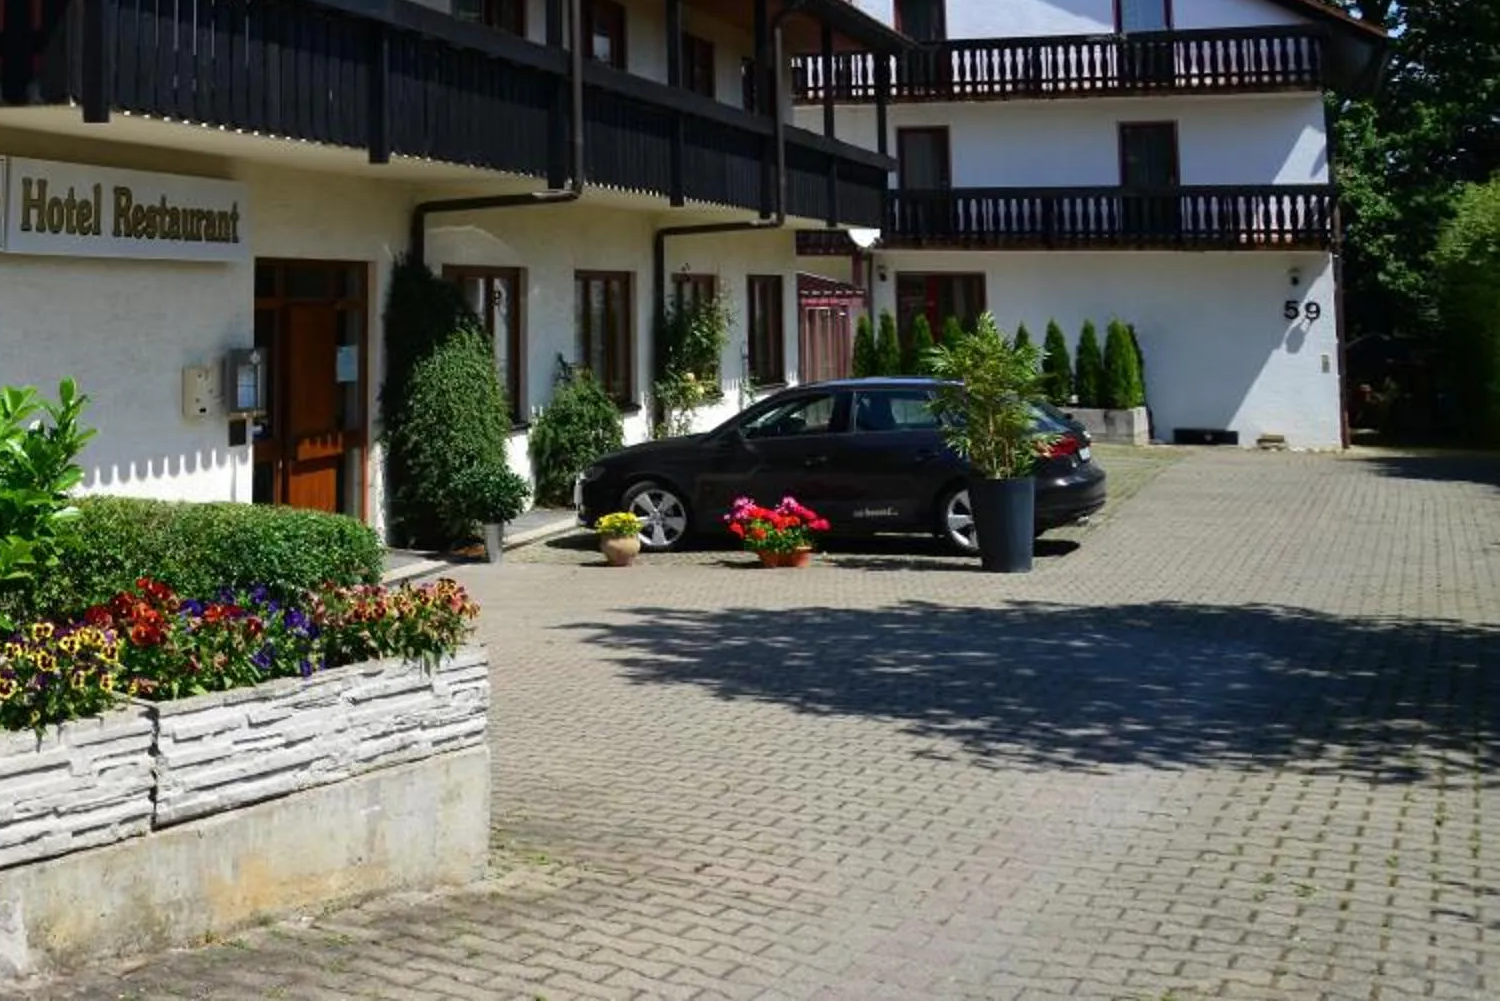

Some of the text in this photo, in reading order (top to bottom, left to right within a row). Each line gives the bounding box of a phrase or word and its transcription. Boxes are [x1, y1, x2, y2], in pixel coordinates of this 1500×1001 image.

[19, 176, 240, 244] Hotel Restaurant
[1284, 300, 1321, 325] 59
